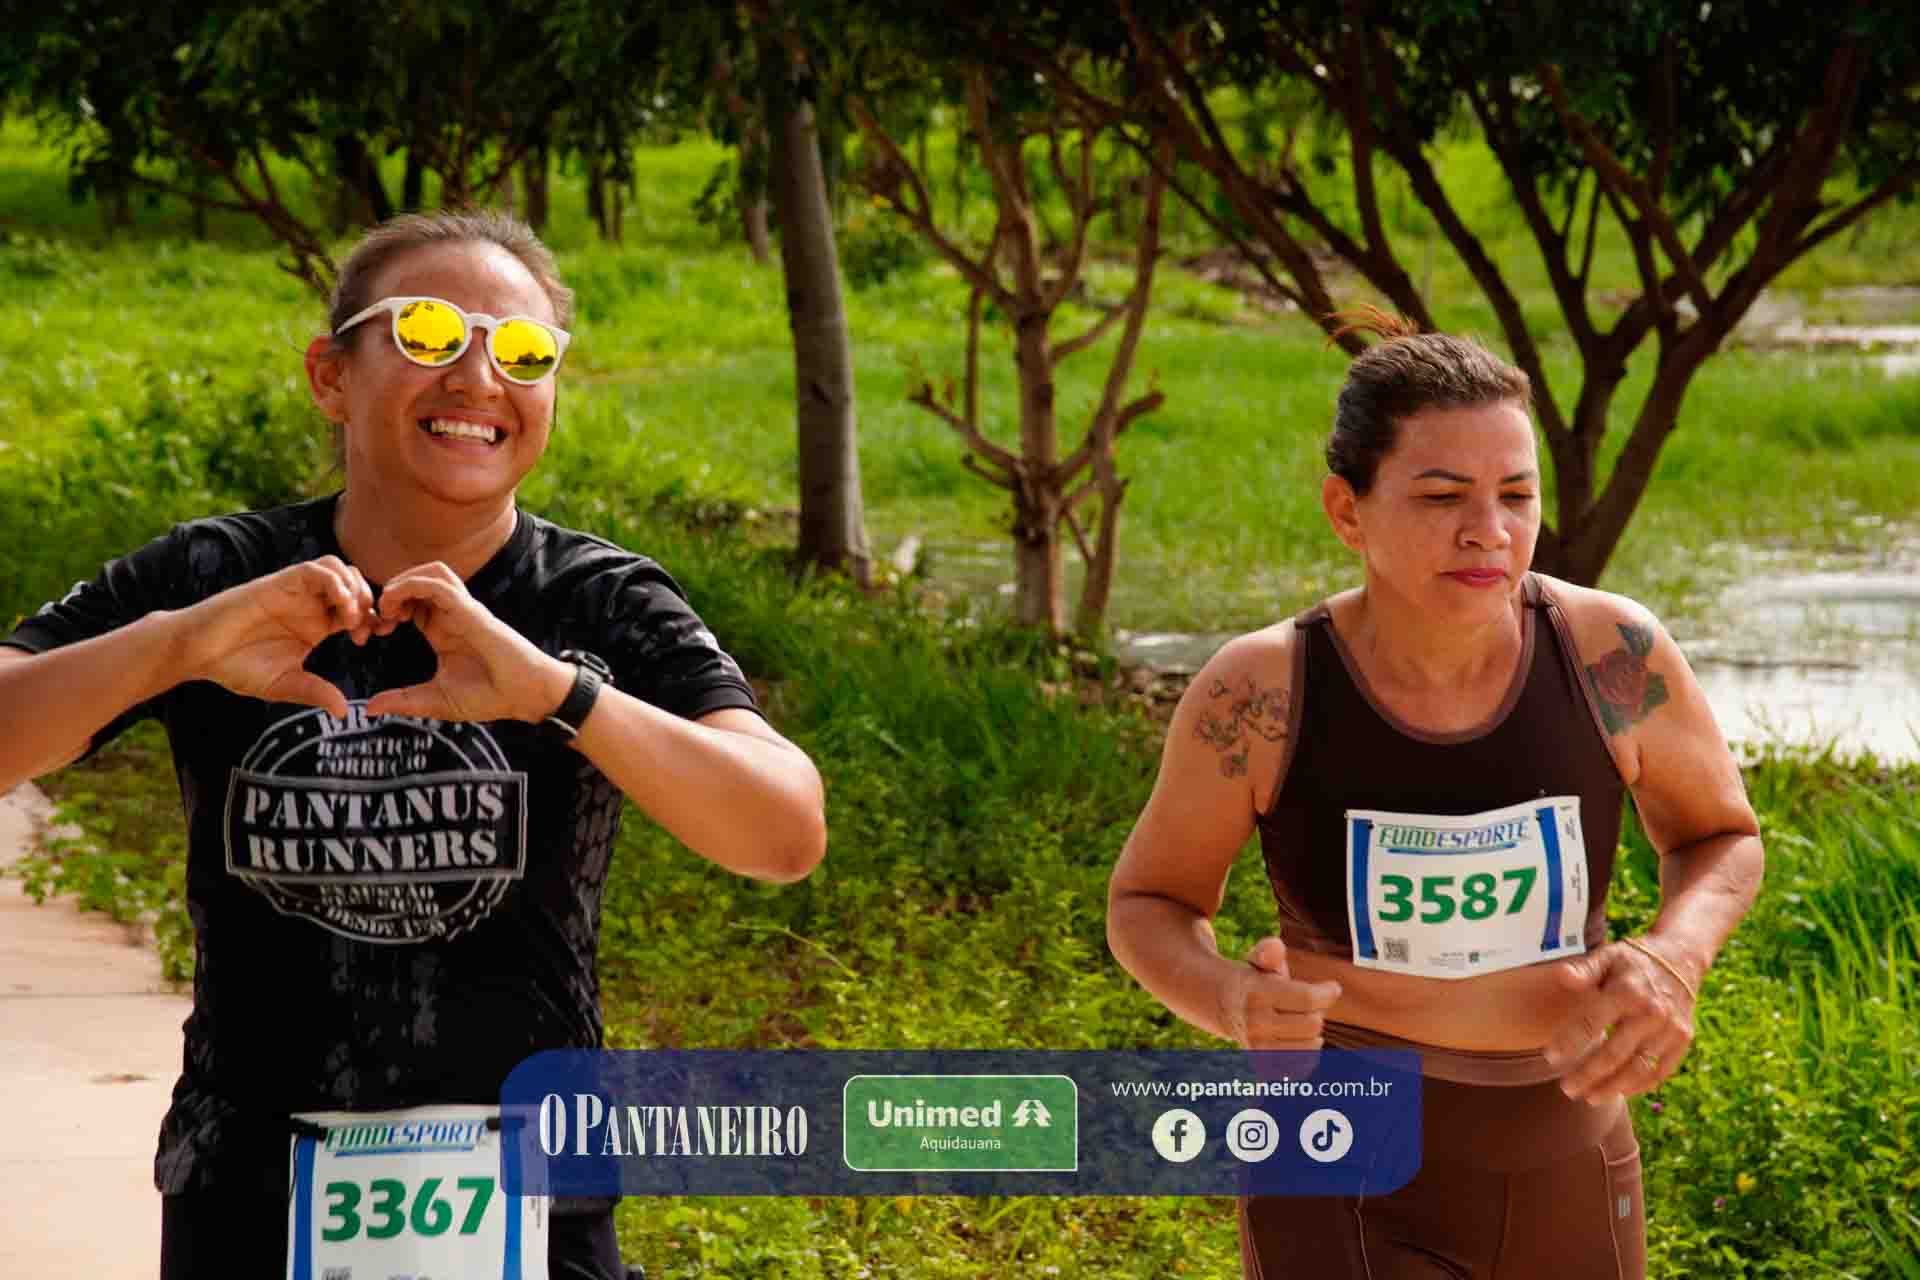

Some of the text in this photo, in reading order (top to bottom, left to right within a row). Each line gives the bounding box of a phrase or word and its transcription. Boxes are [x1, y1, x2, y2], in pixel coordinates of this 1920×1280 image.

[244, 784, 504, 829] PANTANUS
[248, 830, 497, 872] RUNNERS
[1377, 816, 1530, 848] FUNDESPORTE
[1378, 866, 1537, 924] 3587
[321, 1176, 496, 1243] 3367
